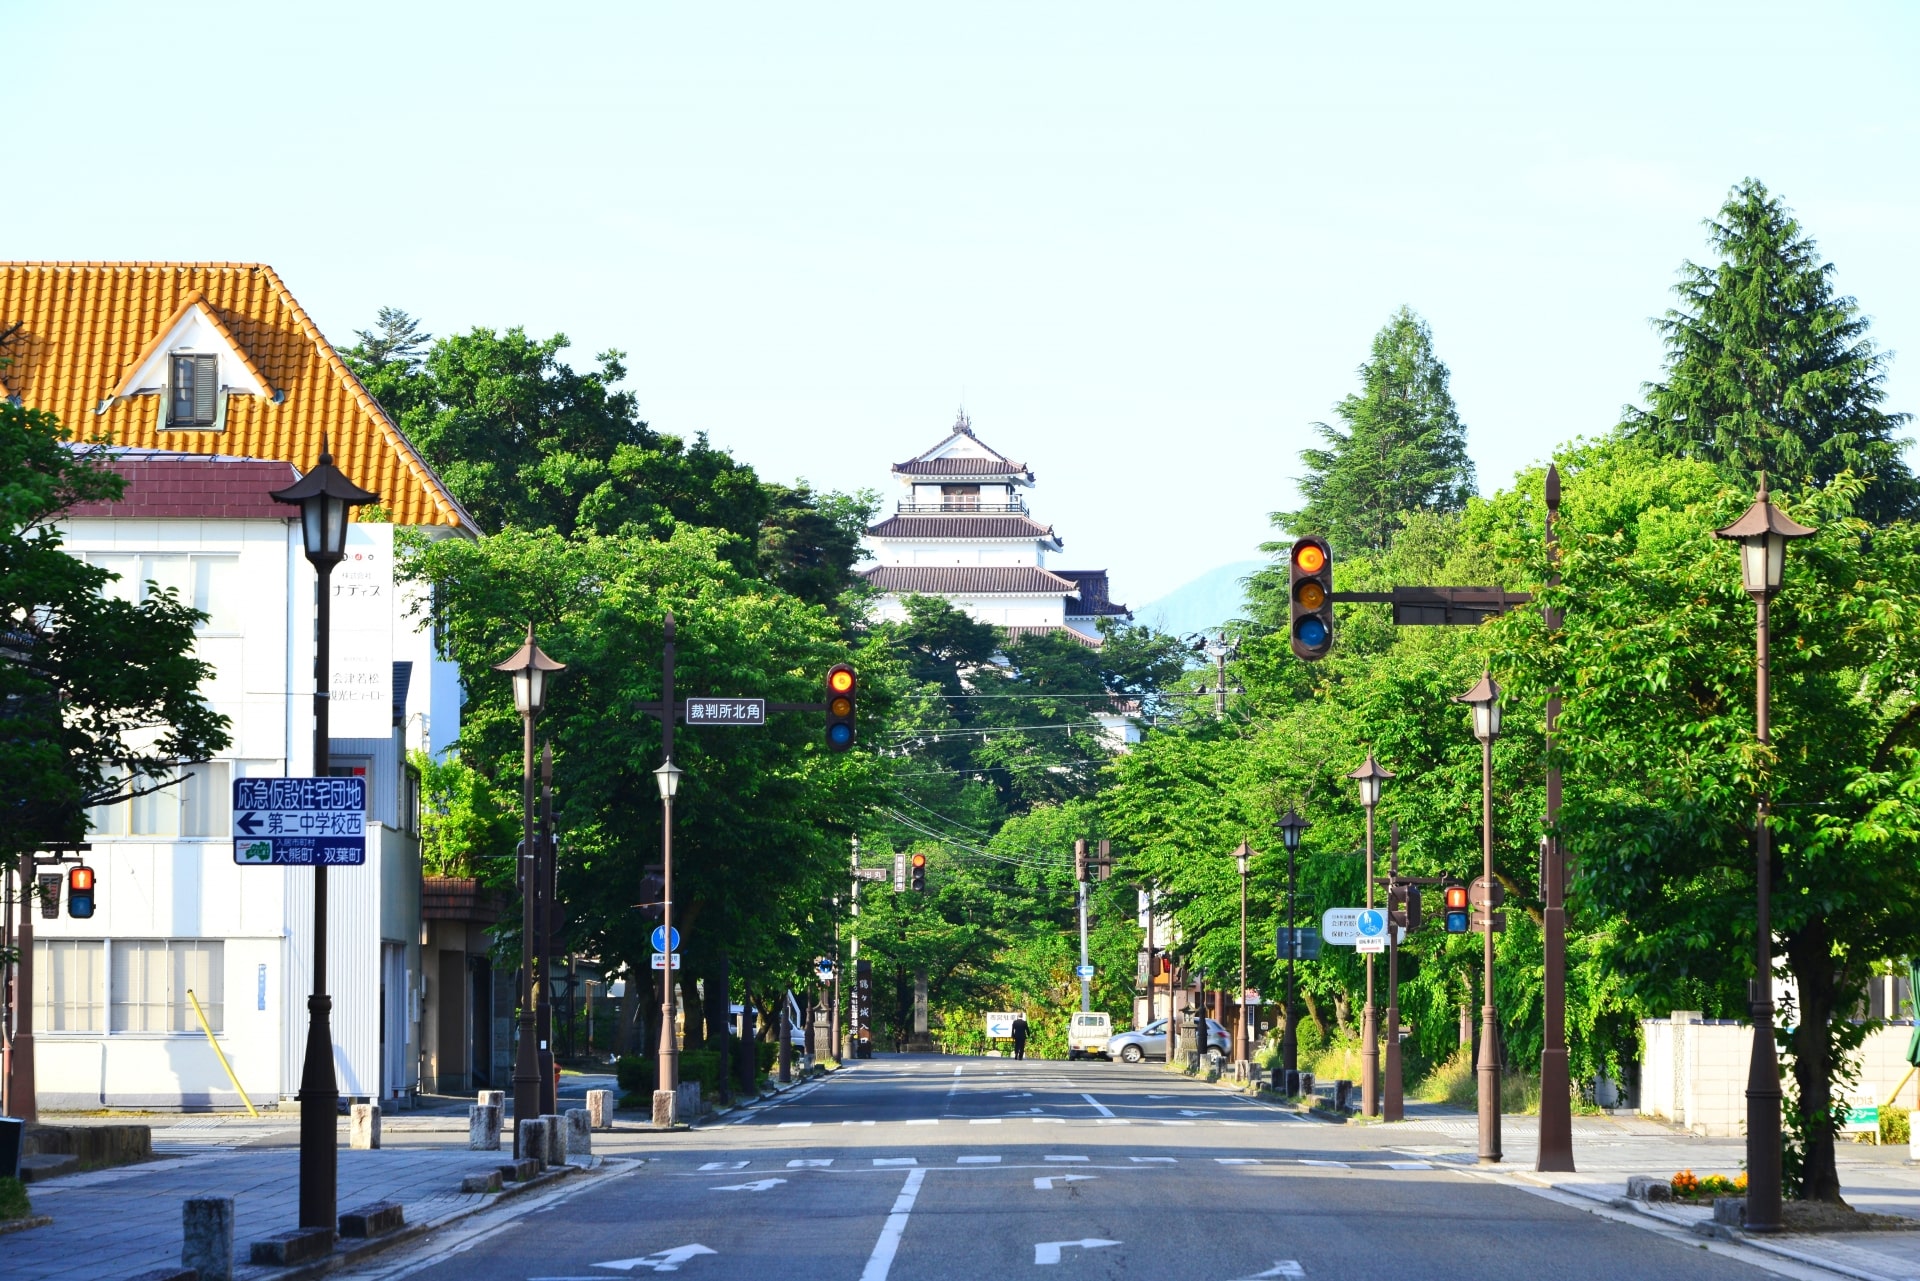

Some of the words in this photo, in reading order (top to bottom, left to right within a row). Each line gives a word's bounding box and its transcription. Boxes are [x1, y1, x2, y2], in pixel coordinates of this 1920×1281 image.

[332, 584, 381, 597] ナディス
[332, 672, 380, 684] 会津若松
[691, 703, 760, 719] 裁判所北角
[237, 780, 362, 809] 応急仮設住宅団地
[268, 812, 362, 835] 第二中学校西
[276, 838, 316, 847] 入居市町村
[275, 847, 361, 863] 大熊町・双葉町
[1846, 1109, 1877, 1119] クシー
